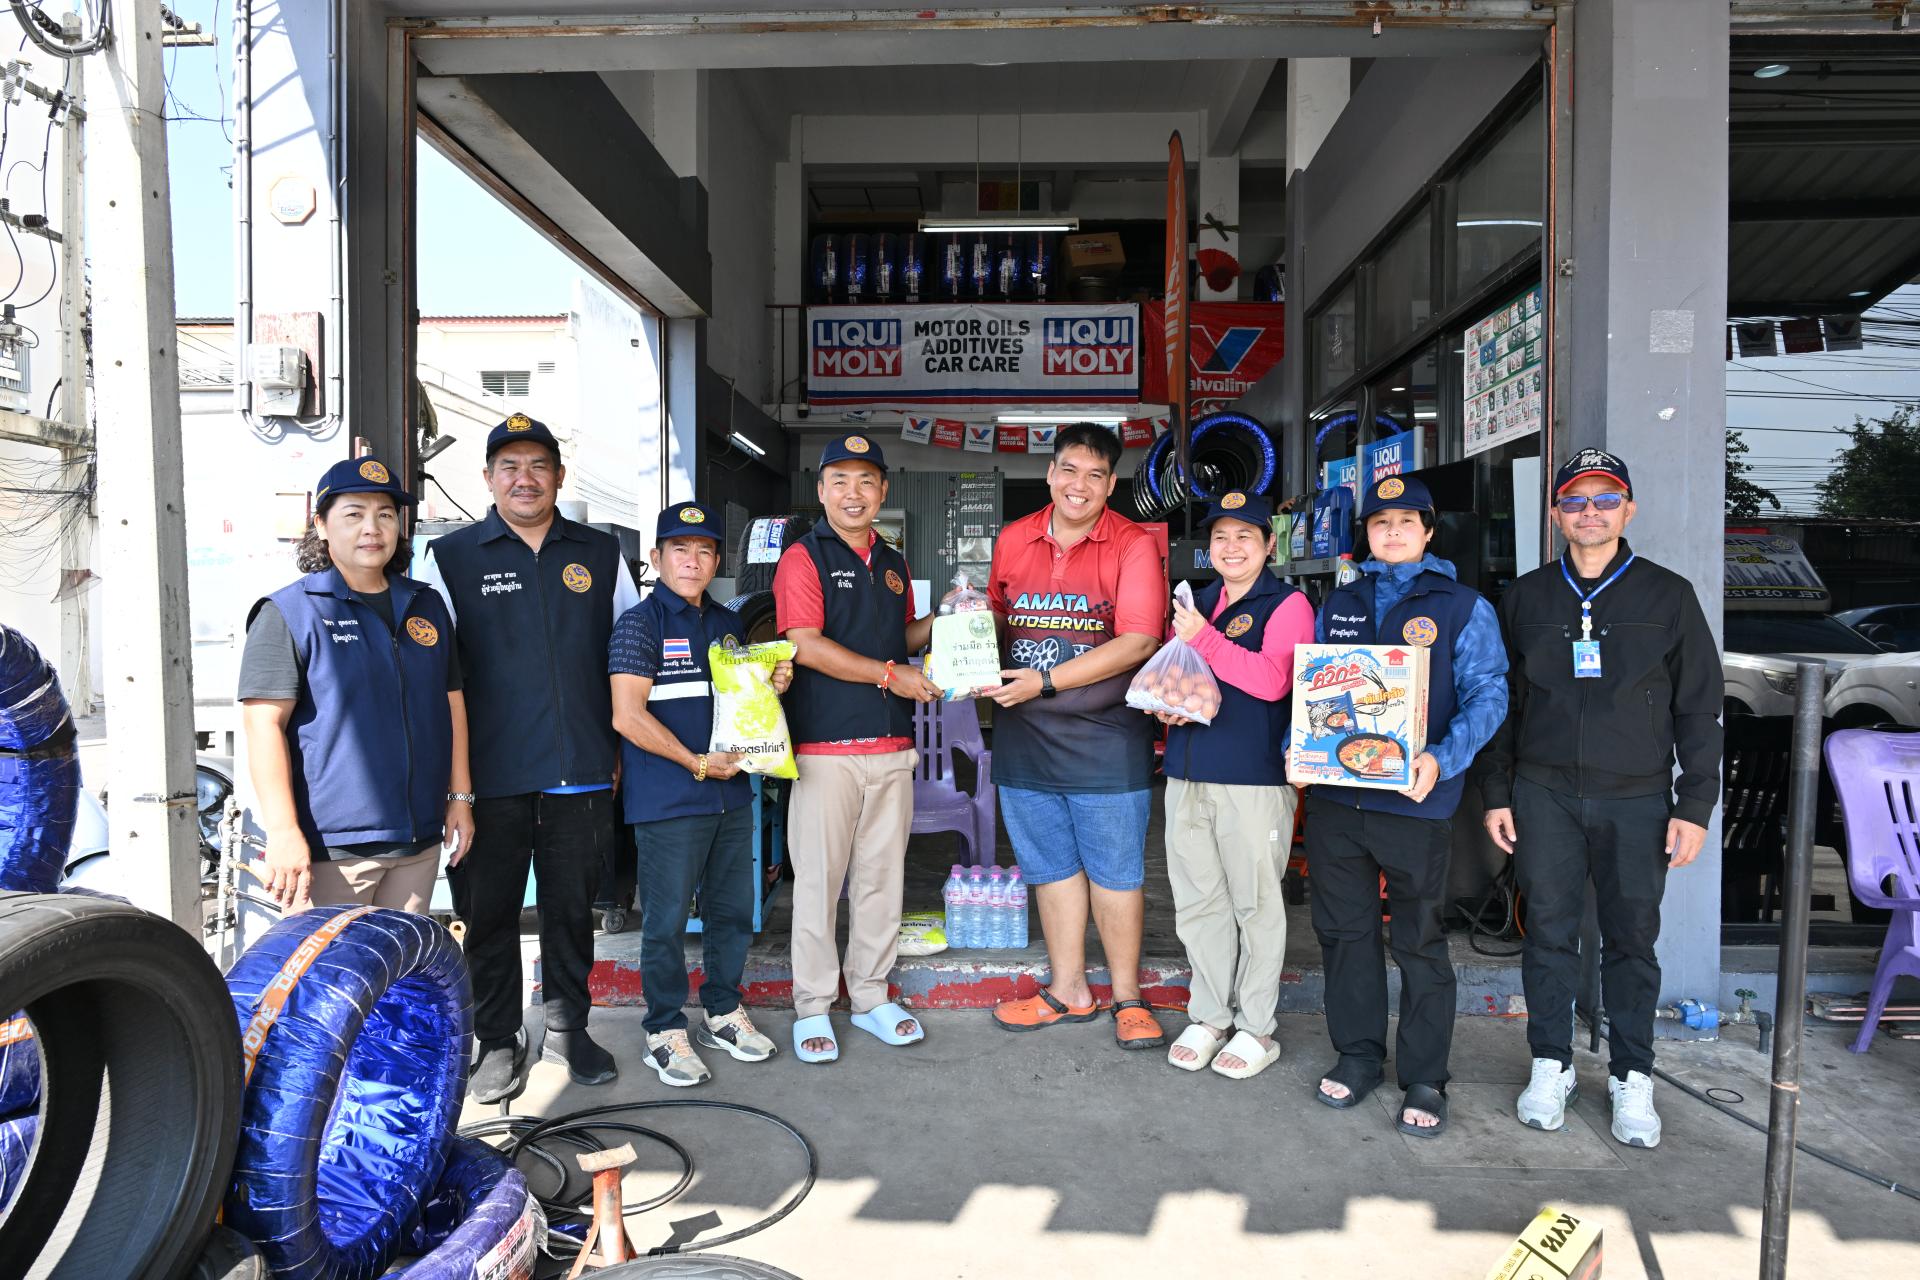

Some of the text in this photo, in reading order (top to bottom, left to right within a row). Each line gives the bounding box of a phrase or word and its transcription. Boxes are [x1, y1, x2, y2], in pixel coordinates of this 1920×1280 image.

[817, 321, 897, 347] LIQUI
[914, 319, 1031, 337] MOTOR OILS
[1048, 319, 1129, 345] LIQUI
[921, 337, 1024, 355] ADDITIVES
[818, 350, 899, 375] MOLY
[925, 355, 1020, 373] CAR CARE
[1048, 348, 1132, 374] MOLY
[1190, 377, 1256, 393] alvolin
[1374, 445, 1400, 467] LIQUI
[1342, 466, 1356, 482] LIQ
[1013, 592, 1089, 613] AMATA
[1313, 664, 1349, 687] ควิก
[1540, 1213, 1581, 1253] KYB
